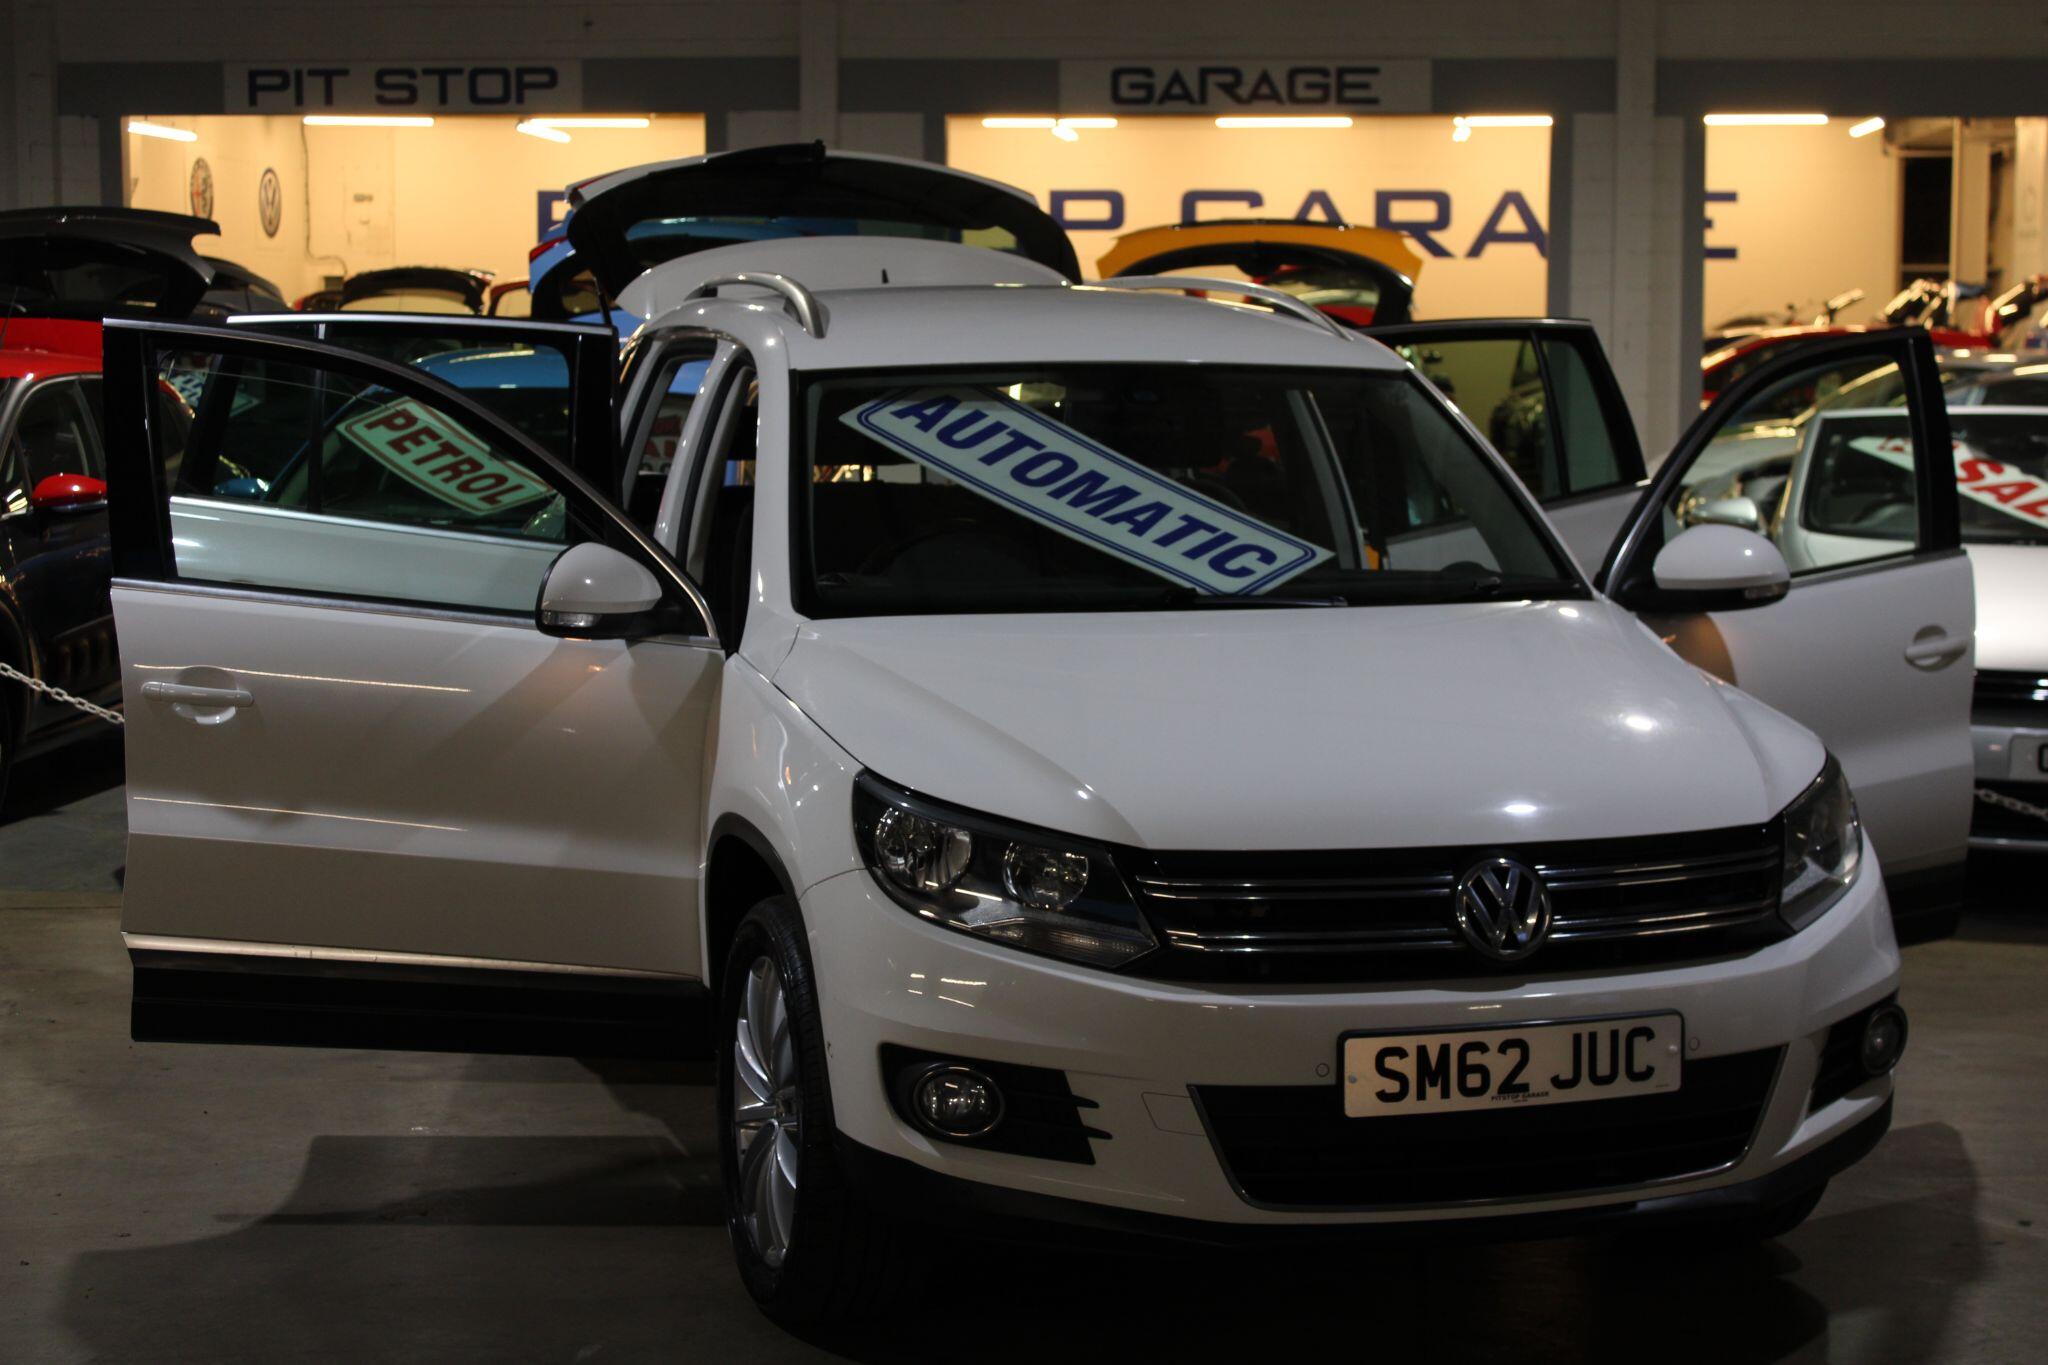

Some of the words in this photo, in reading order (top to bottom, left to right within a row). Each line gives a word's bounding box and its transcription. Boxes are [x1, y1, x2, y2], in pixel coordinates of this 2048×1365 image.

[248, 69, 349, 106] PIT
[375, 67, 558, 105] STOP
[1111, 67, 1380, 104] GARAGE
[364, 408, 526, 505] PETROL
[890, 394, 1277, 579] AUTOMATIC
[1374, 1038, 1530, 1104] SM62
[1551, 1026, 1656, 1090] JUC
